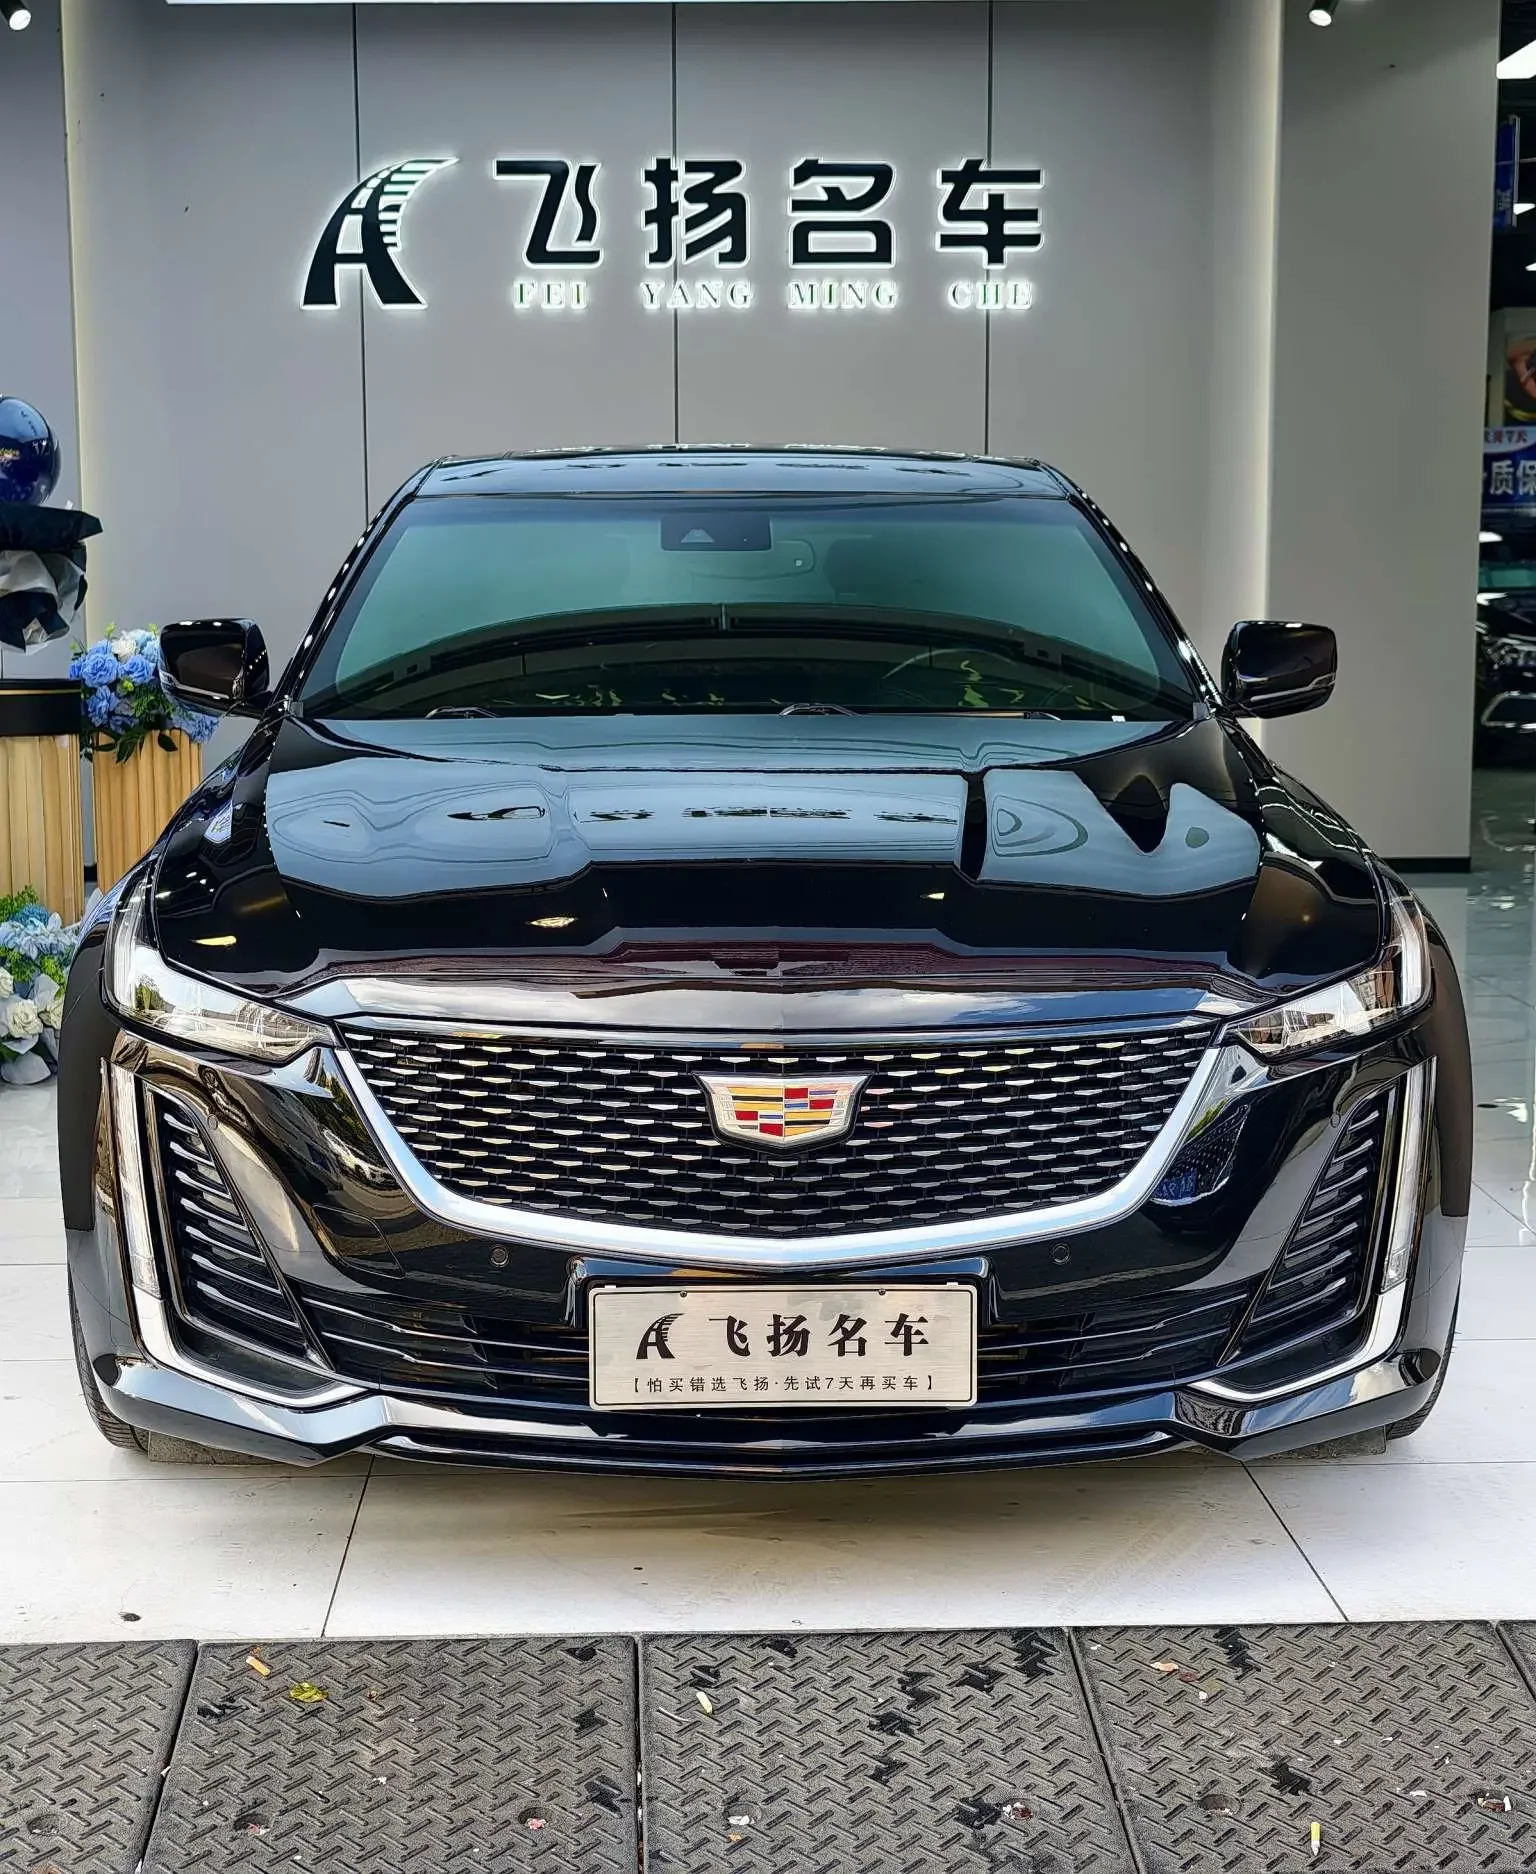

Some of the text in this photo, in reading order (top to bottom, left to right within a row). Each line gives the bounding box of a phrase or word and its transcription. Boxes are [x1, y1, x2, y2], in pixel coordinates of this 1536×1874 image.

[495, 157, 1043, 266] 飞扬名车
[514, 281, 1033, 307] FEI YANG MING CHE
[1483, 459, 1536, 496] 质保
[709, 1313, 929, 1357] 飞扬名车
